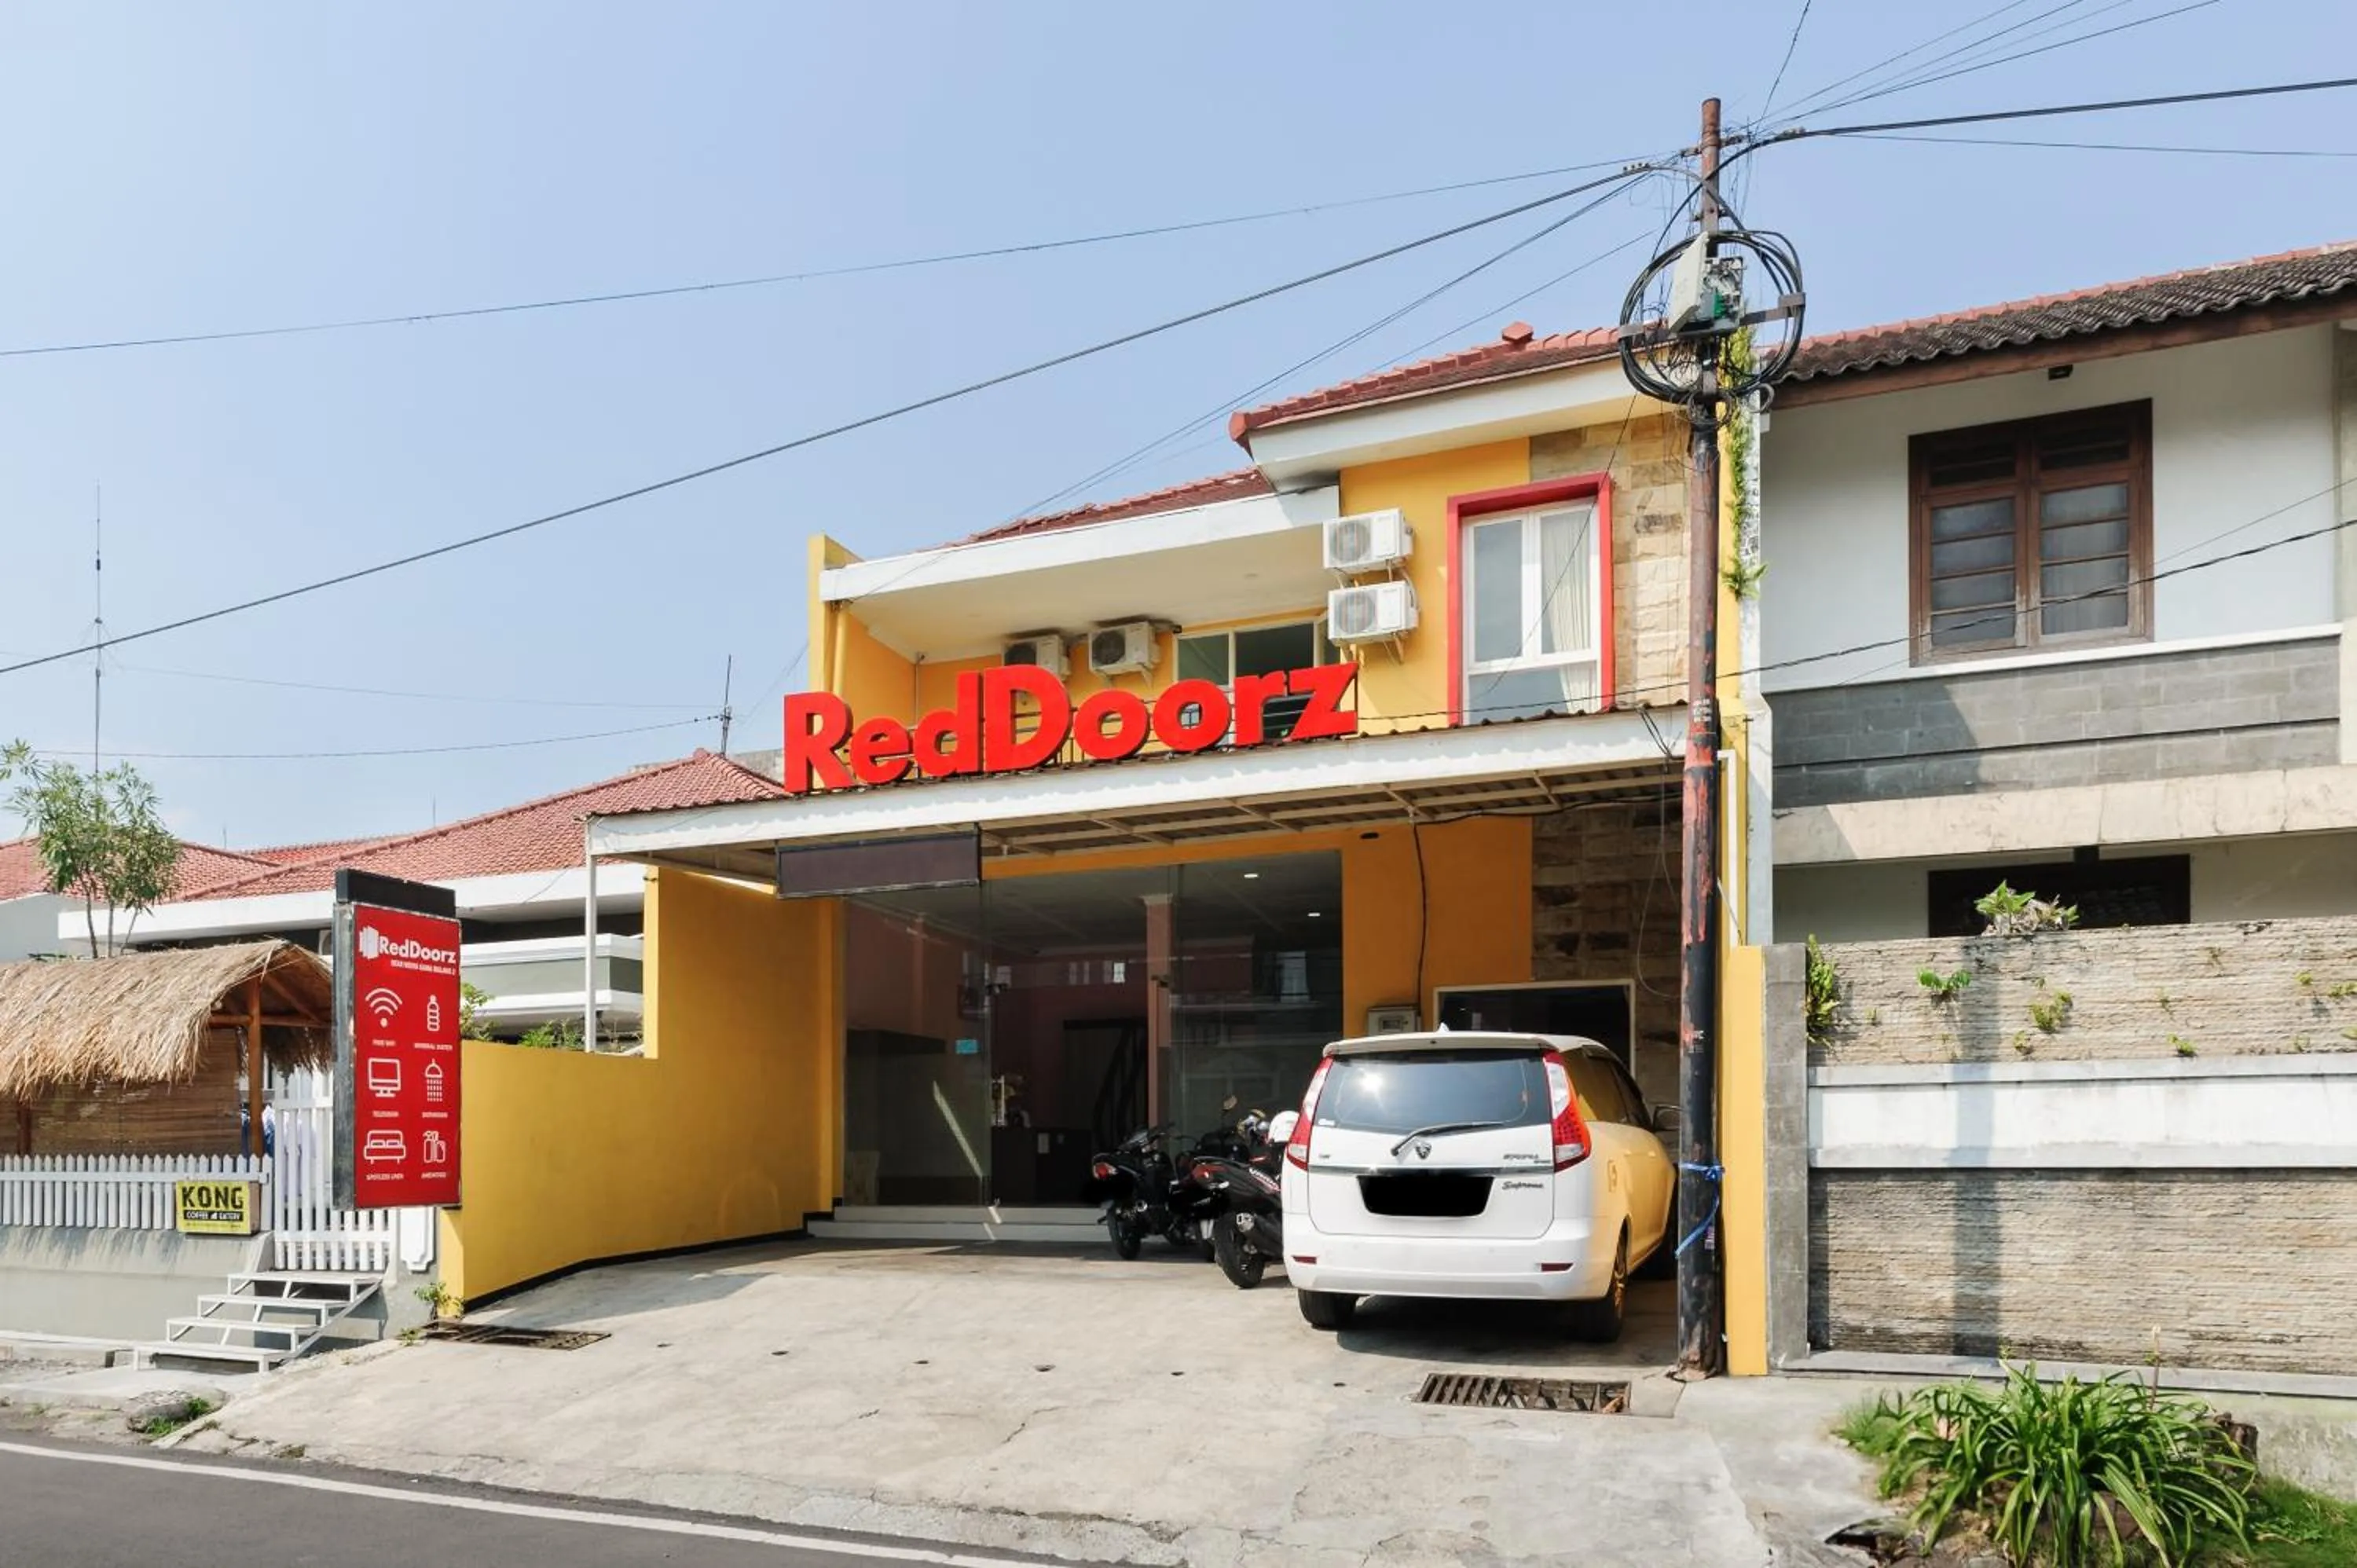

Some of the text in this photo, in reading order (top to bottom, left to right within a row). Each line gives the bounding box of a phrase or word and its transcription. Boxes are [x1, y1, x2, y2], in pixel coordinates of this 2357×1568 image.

[784, 662, 1358, 793] RedDoorz
[379, 936, 456, 964] RedDoorz
[181, 1185, 243, 1210] KONG
